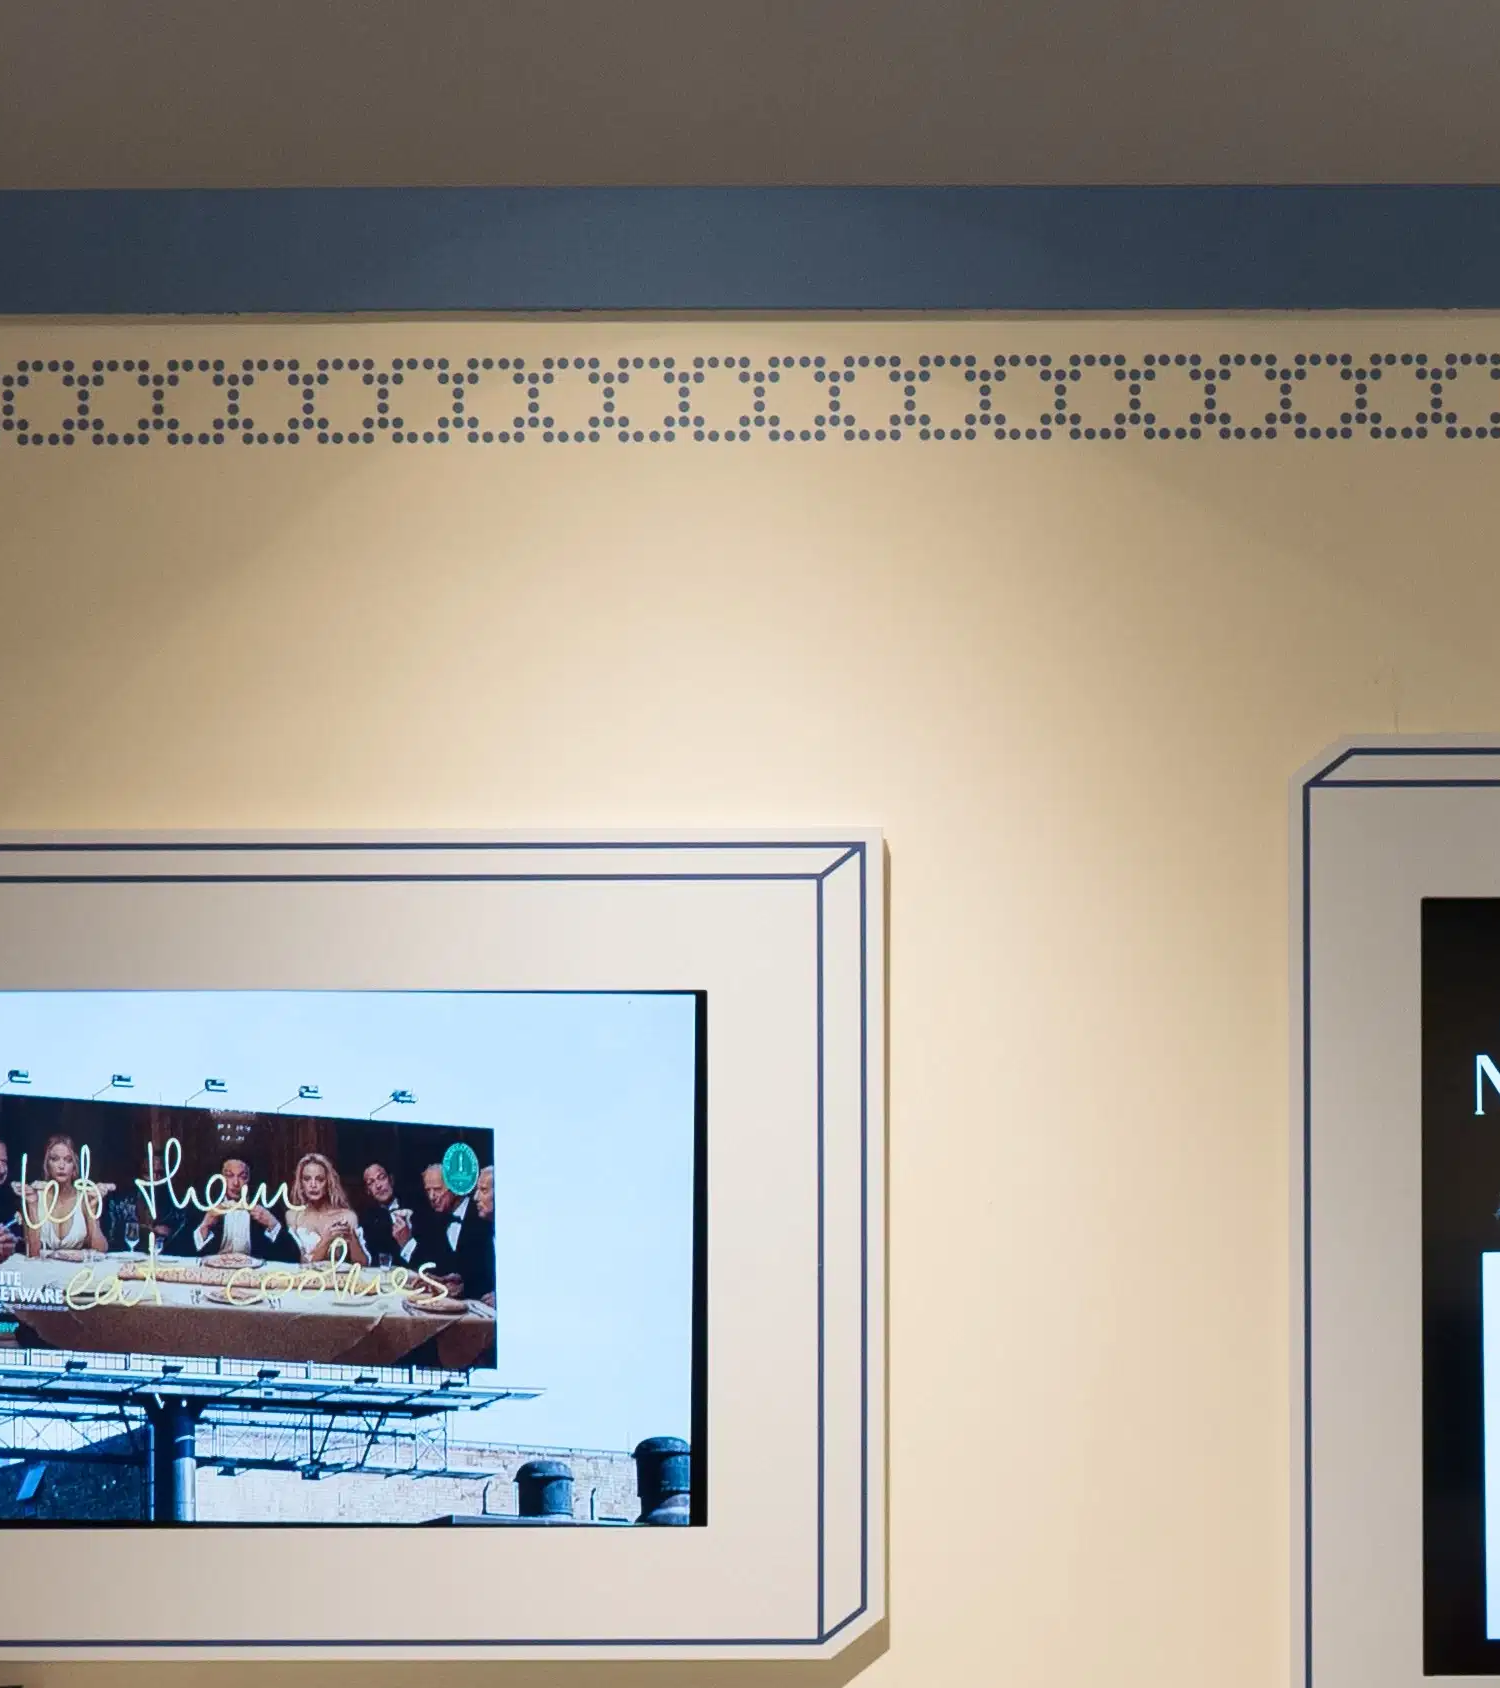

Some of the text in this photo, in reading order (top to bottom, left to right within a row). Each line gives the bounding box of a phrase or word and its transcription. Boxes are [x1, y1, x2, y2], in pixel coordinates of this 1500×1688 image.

[136, 1137, 306, 1220] them
[67, 1232, 451, 1310] eat cookies
